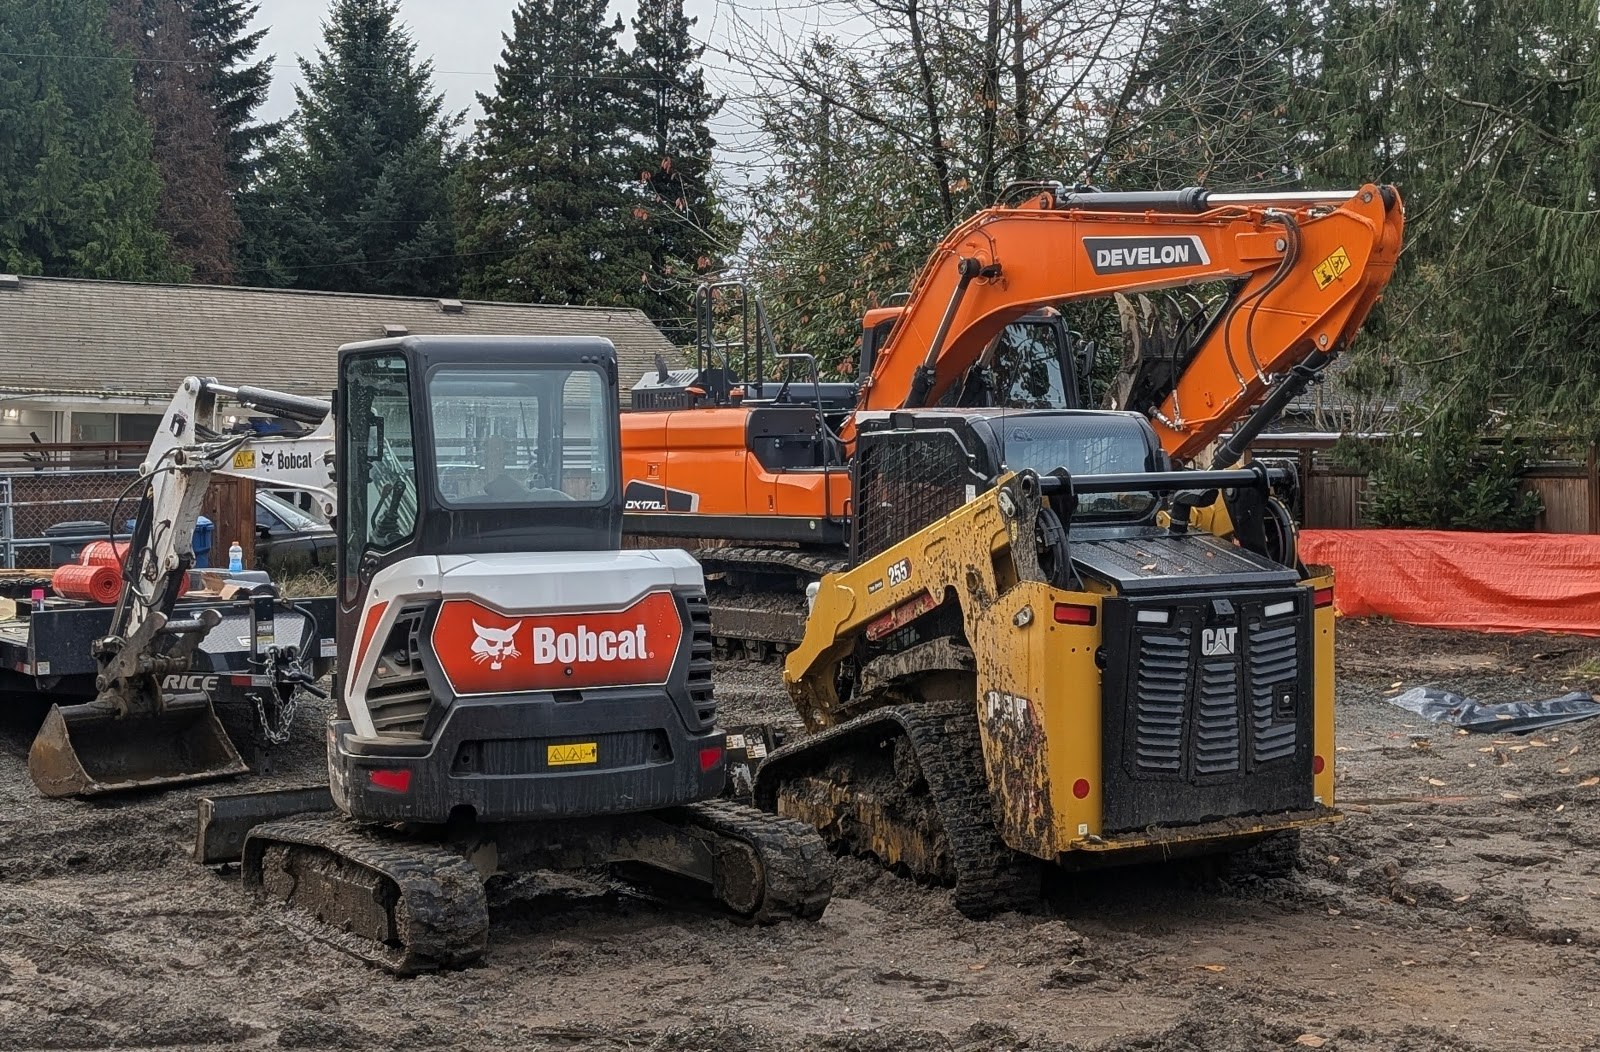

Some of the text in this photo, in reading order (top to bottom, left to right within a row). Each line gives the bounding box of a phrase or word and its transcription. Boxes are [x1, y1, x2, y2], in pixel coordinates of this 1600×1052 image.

[1097, 245, 1189, 267] DEVELON
[277, 452, 312, 470] Bobcat
[888, 560, 908, 587] 255
[533, 624, 647, 664] Bobcat
[1202, 627, 1238, 656] CAT
[162, 674, 219, 691] RICE
